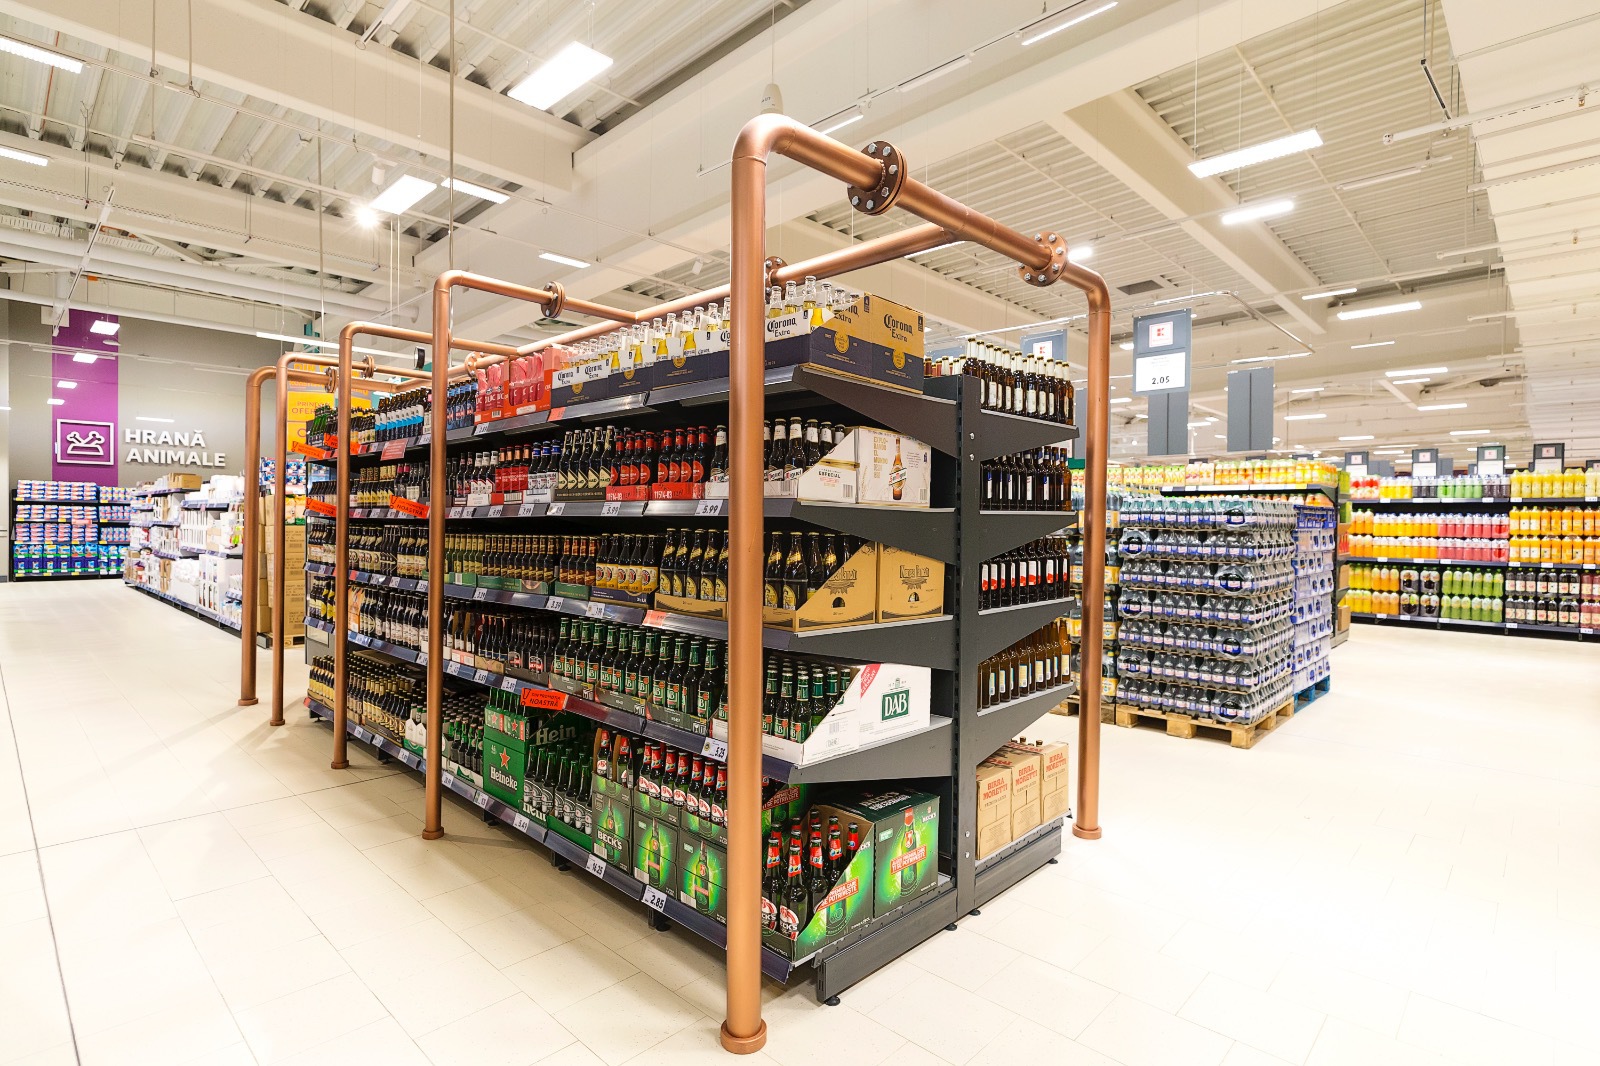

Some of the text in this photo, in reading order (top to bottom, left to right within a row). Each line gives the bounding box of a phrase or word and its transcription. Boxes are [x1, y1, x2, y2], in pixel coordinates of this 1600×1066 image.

[767, 317, 797, 333] Corona
[883, 313, 914, 335] Corona
[891, 329, 908, 342] Extra
[1151, 375, 1170, 385] 2.05
[125, 428, 206, 448] HRANĂ
[125, 448, 226, 467] ANIMALE
[702, 505, 719, 514] 5.99
[884, 693, 908, 717] DAB
[535, 724, 577, 746] Hein
[1045, 758, 1067, 773] MORETTI
[1049, 753, 1063, 764] BIRRA
[1015, 769, 1038, 786] MORETTI
[1018, 764, 1034, 777] BIRRA
[982, 783, 1008, 801] MORETTI
[987, 777, 1005, 791] BIRRA
[598, 829, 623, 850] BECK'S
[650, 894, 665, 910] 2.85
